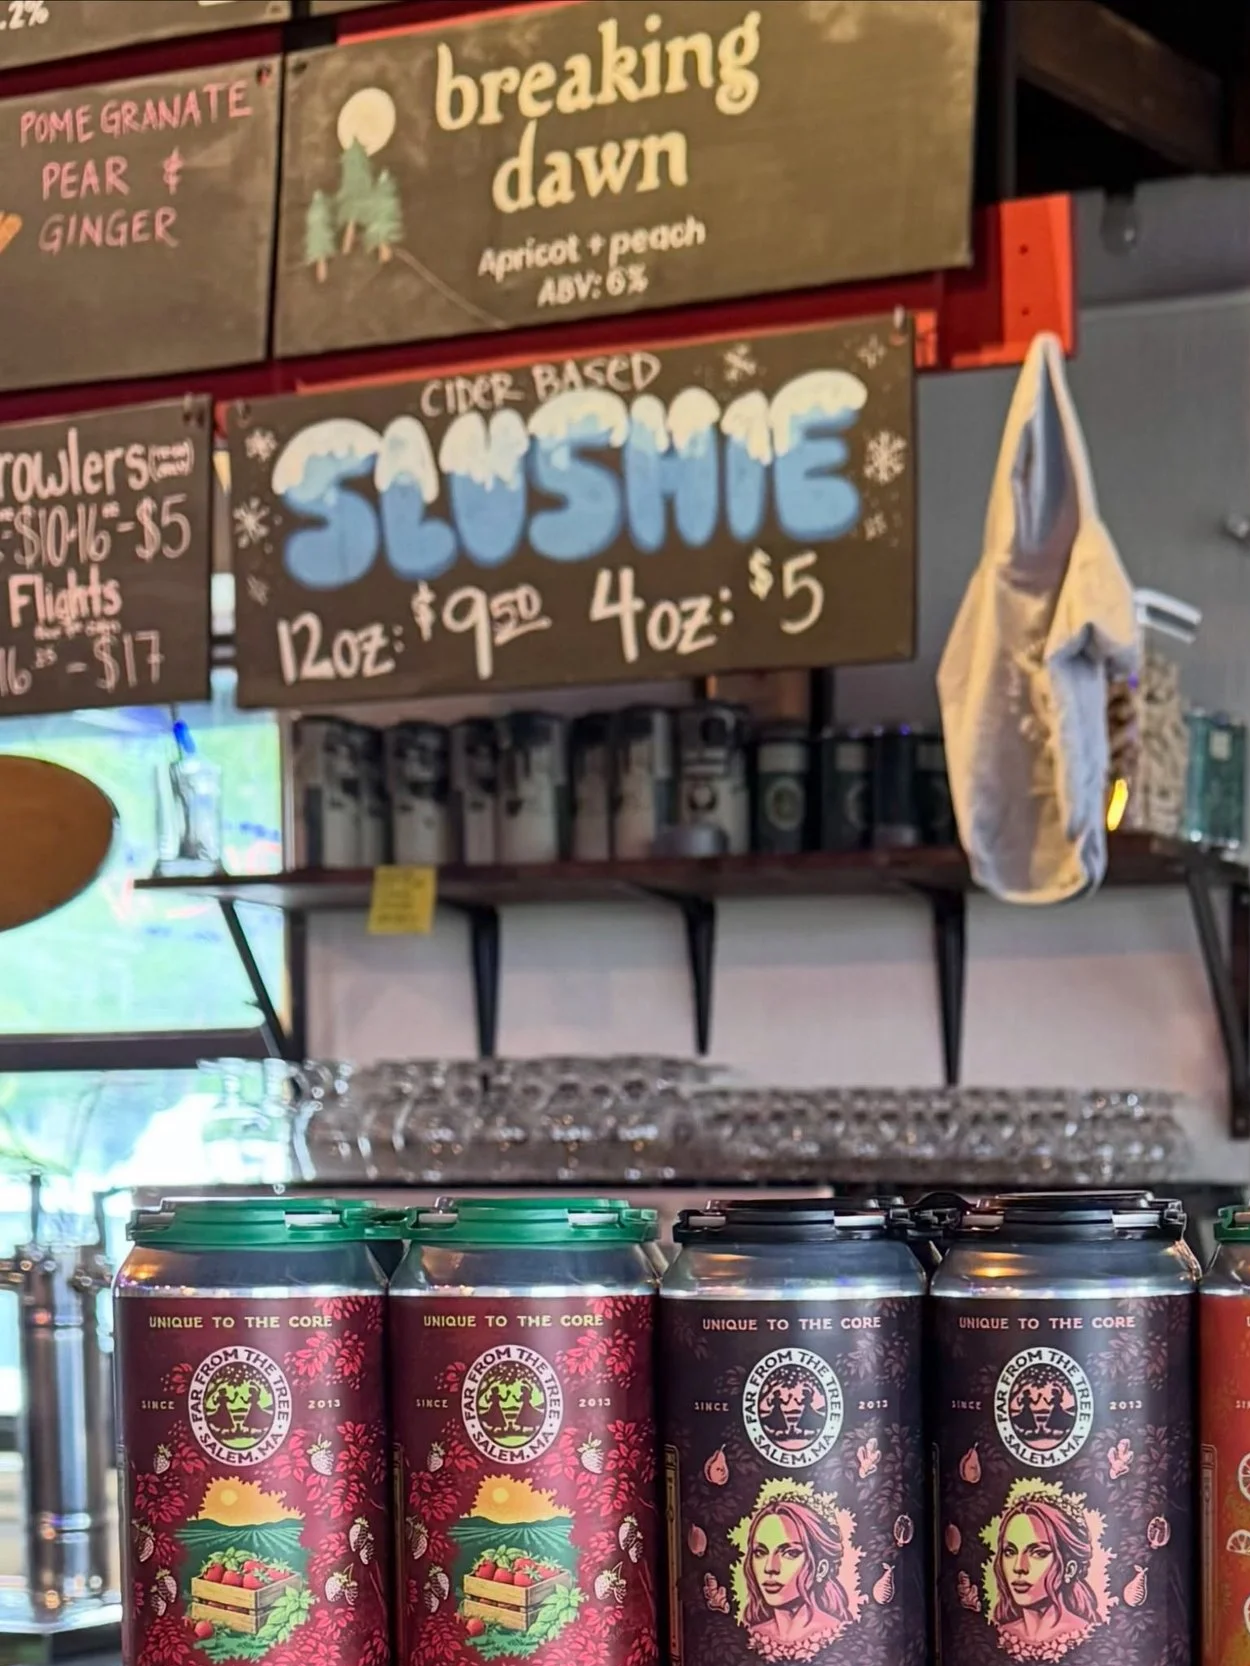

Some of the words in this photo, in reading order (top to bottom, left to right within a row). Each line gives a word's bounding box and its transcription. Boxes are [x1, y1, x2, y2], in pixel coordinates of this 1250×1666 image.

[436, 10, 762, 130] breaking
[42, 155, 131, 200] PEAR
[493, 121, 688, 213] dawn
[38, 207, 180, 256] GINGER
[477, 233, 580, 284] Apricot
[609, 215, 706, 266] peach
[537, 272, 601, 307] ABV:
[606, 264, 648, 296] 6%
[421, 373, 524, 418] CIDER
[271, 369, 868, 590] SLUSHIE
[8, 564, 122, 628] Flights
[589, 565, 735, 664] 4oz:
[747, 547, 825, 635] $5
[149, 1316, 204, 1329] UNIQUE
[212, 1316, 235, 1329] TO
[244, 1316, 280, 1328] THE
[288, 1315, 333, 1328] CORE
[197, 1348, 239, 1384] FROM
[244, 1349, 278, 1376] THE
[141, 1400, 175, 1410] SINCE
[308, 1399, 341, 1410] 2013
[191, 1388, 204, 1423] FAR
[272, 1374, 290, 1422] TREE
[260, 1432, 284, 1458] MA
